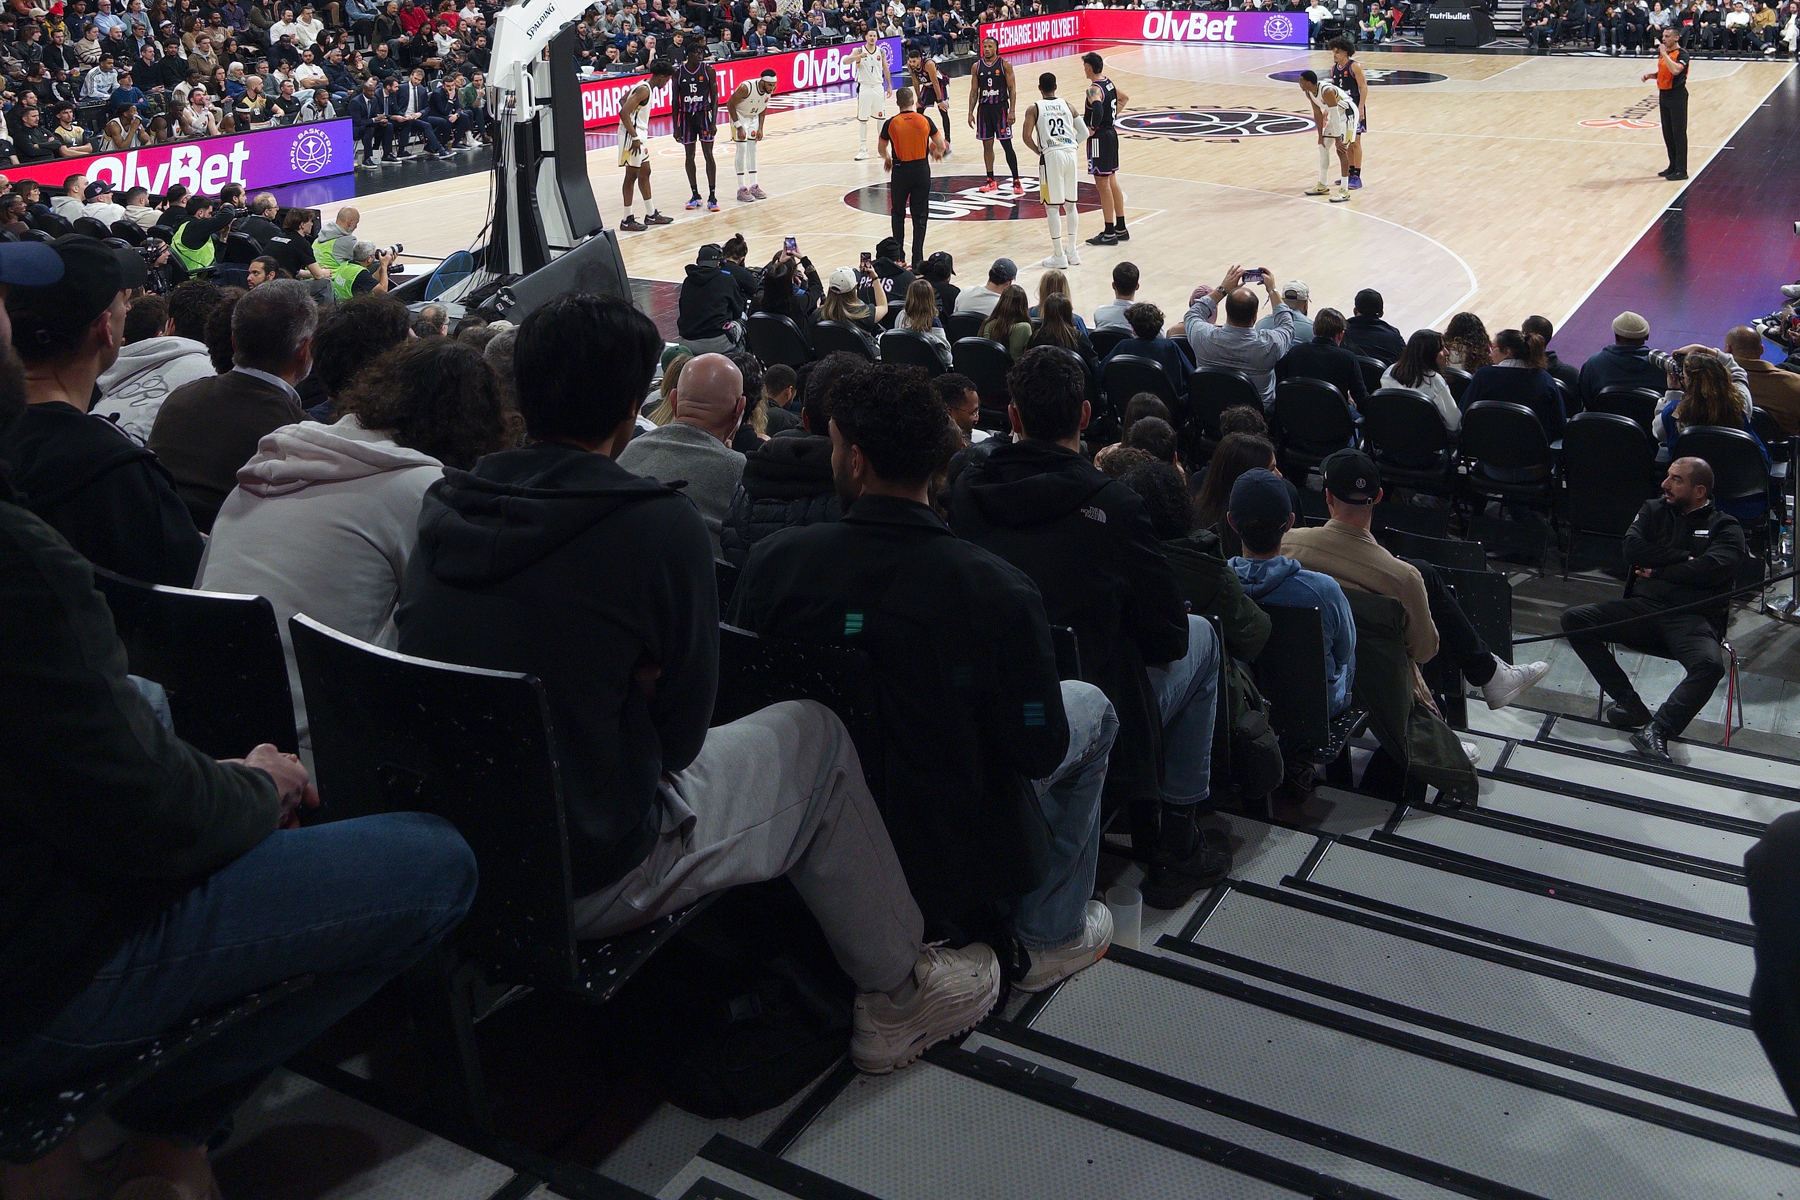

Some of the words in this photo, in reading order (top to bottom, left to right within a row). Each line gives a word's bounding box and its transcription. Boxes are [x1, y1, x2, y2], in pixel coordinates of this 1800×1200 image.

[1430, 11, 1471, 20] nutribullet
[526, 2, 556, 40] SPALDING
[1032, 20, 1050, 42] L'APP
[1051, 16, 1076, 39] OLYBET
[1143, 11, 1238, 42] OlyBet
[987, 78, 993, 87] 9
[689, 84, 698, 92] 15
[982, 90, 1000, 98] OlyBet
[684, 95, 704, 104] OlyBet
[1048, 118, 1065, 137] 23
[72, 138, 78, 146] 2
[290, 140, 299, 171] PARIS
[298, 128, 333, 165] BASKETBALL
